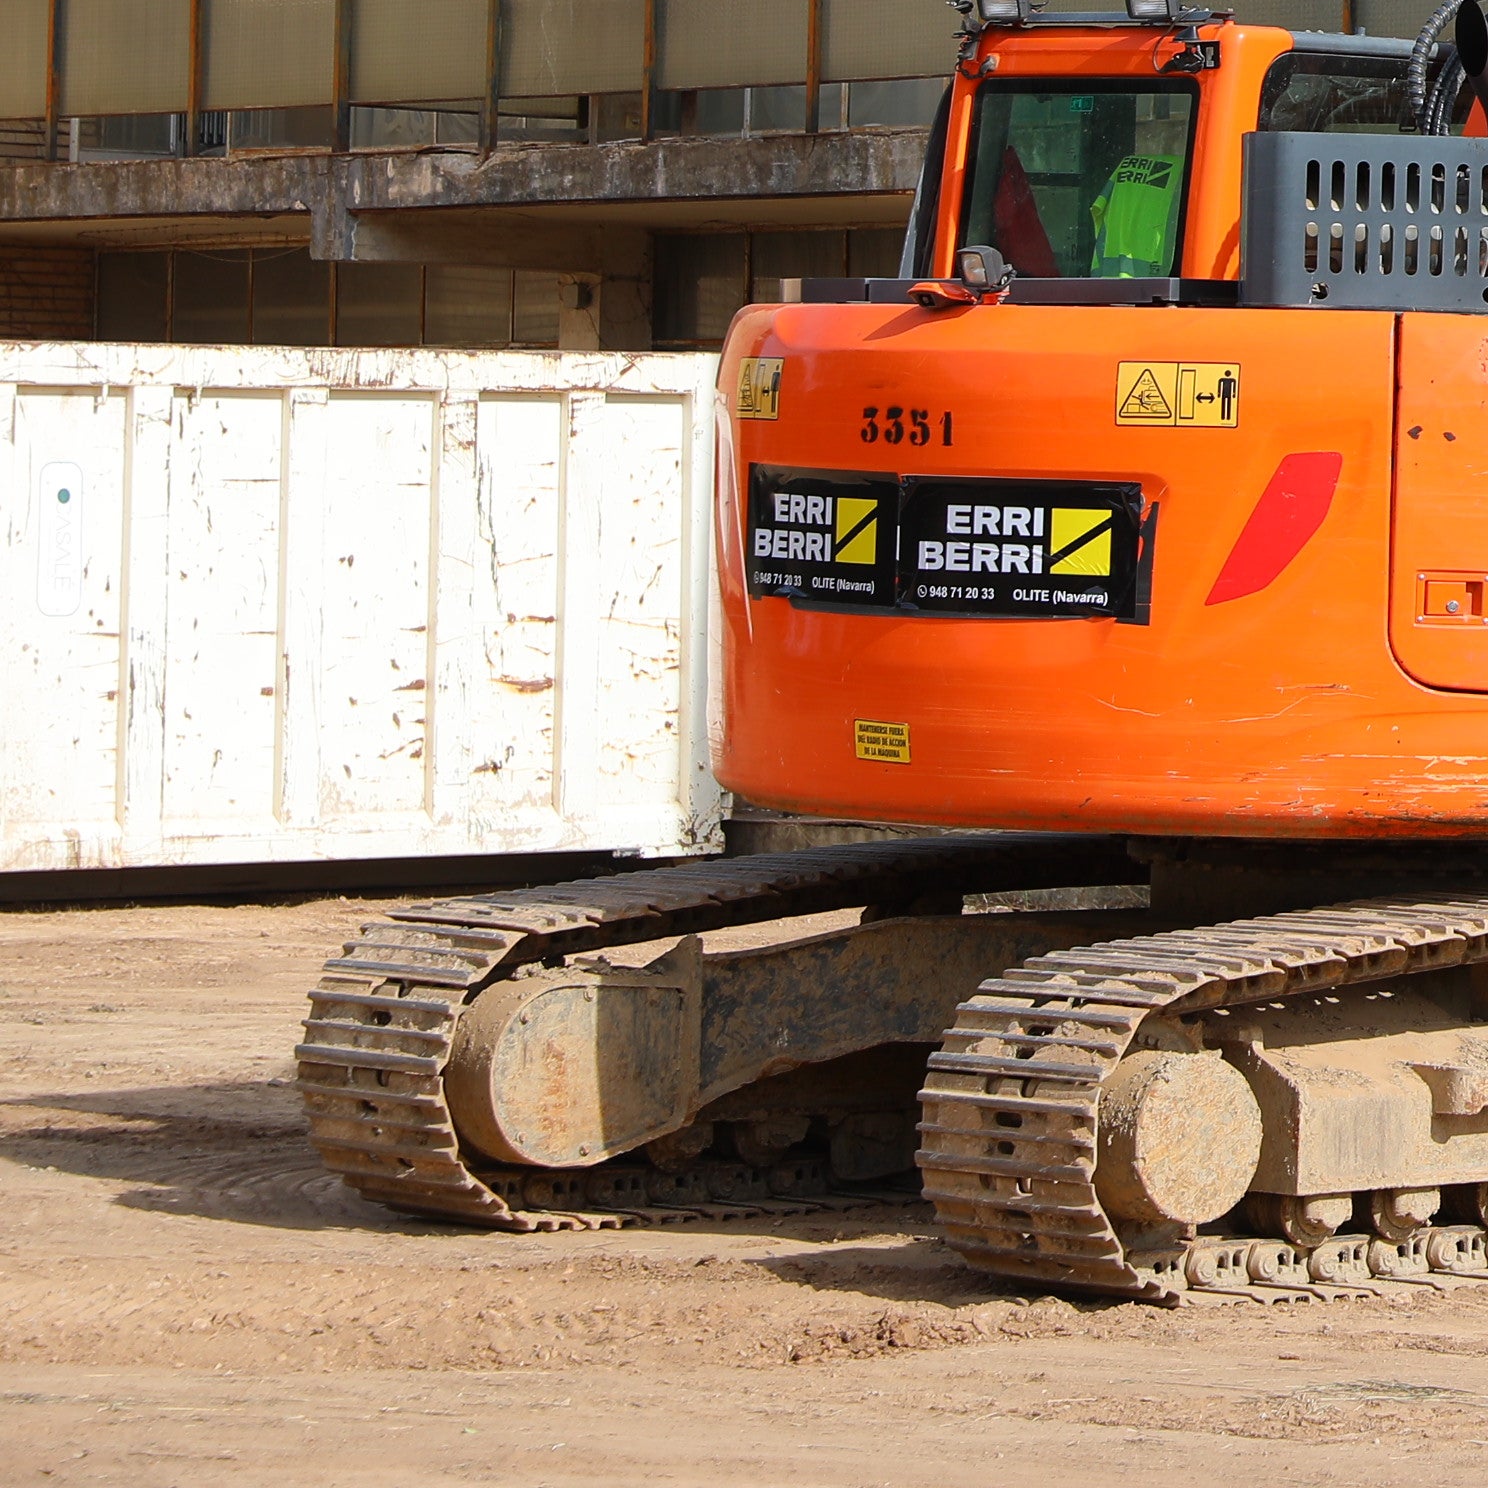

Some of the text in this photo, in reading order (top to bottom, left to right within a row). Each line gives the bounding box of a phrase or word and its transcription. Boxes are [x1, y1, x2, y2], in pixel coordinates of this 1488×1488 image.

[1117, 170, 1147, 184] ERRI
[1121, 157, 1153, 170] ERRI
[861, 406, 954, 446] 3351
[774, 493, 833, 526] ERRI
[947, 505, 1044, 537] ERRI
[754, 528, 832, 562] BERRI
[918, 541, 1043, 574] BERRI
[773, 573, 782, 585] 71
[784, 573, 793, 586] 20
[793, 575, 802, 587] 33
[812, 577, 835, 590] OLITE
[837, 579, 875, 594] (Navarra)
[929, 585, 1109, 606] 948 71 20 33 OLITE (Navarra)
